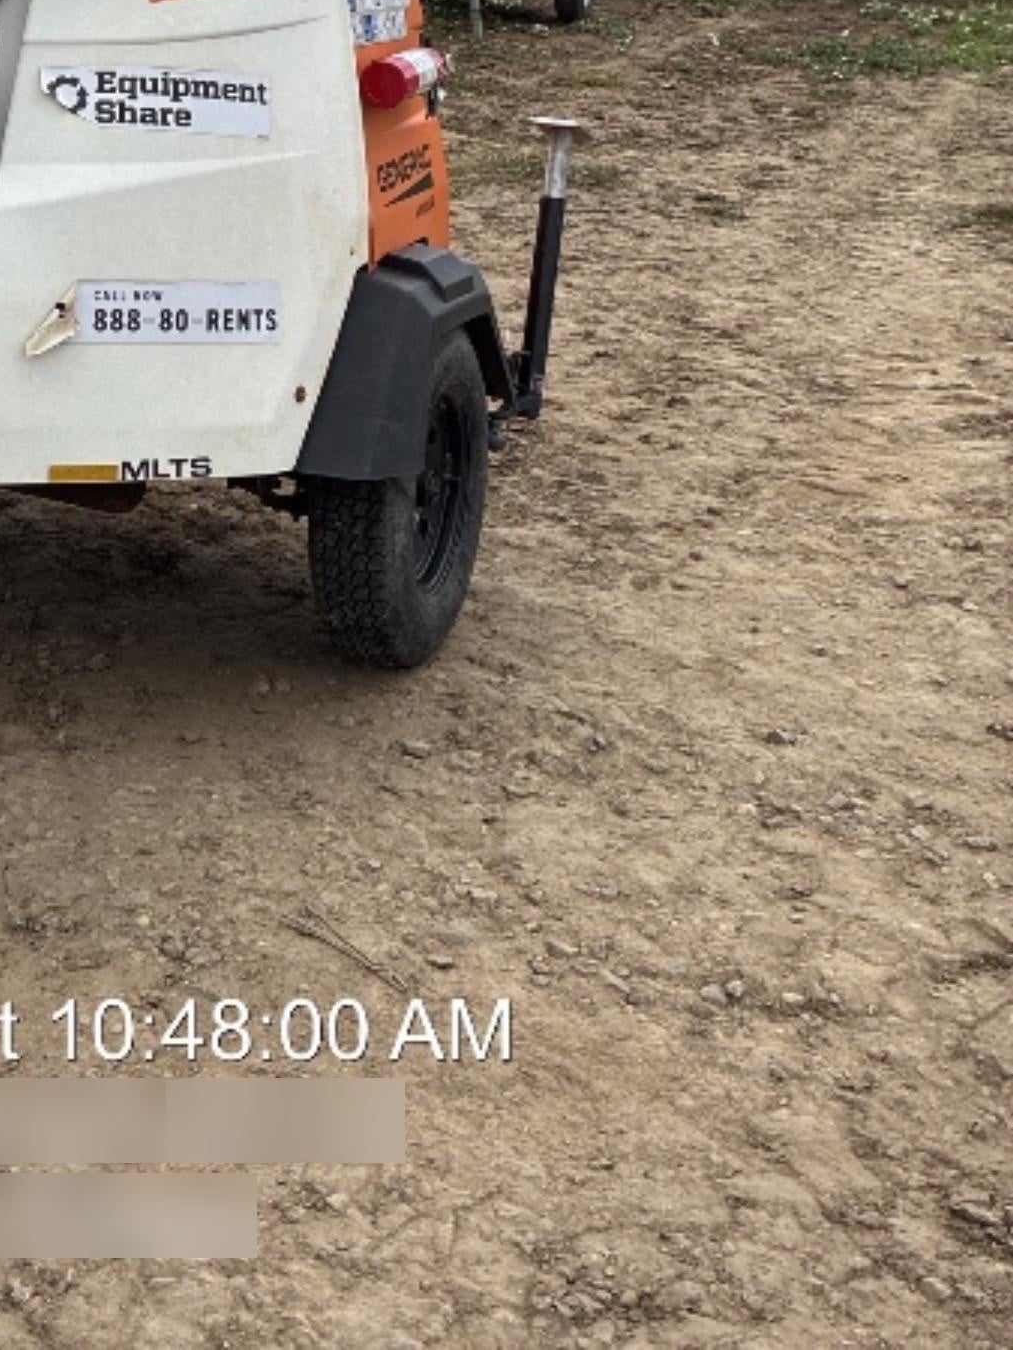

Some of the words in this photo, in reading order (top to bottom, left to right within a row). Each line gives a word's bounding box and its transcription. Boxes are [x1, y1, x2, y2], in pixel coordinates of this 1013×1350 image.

[94, 70, 268, 105] Equipment
[94, 100, 192, 126] Share
[121, 456, 213, 481] MLTS
